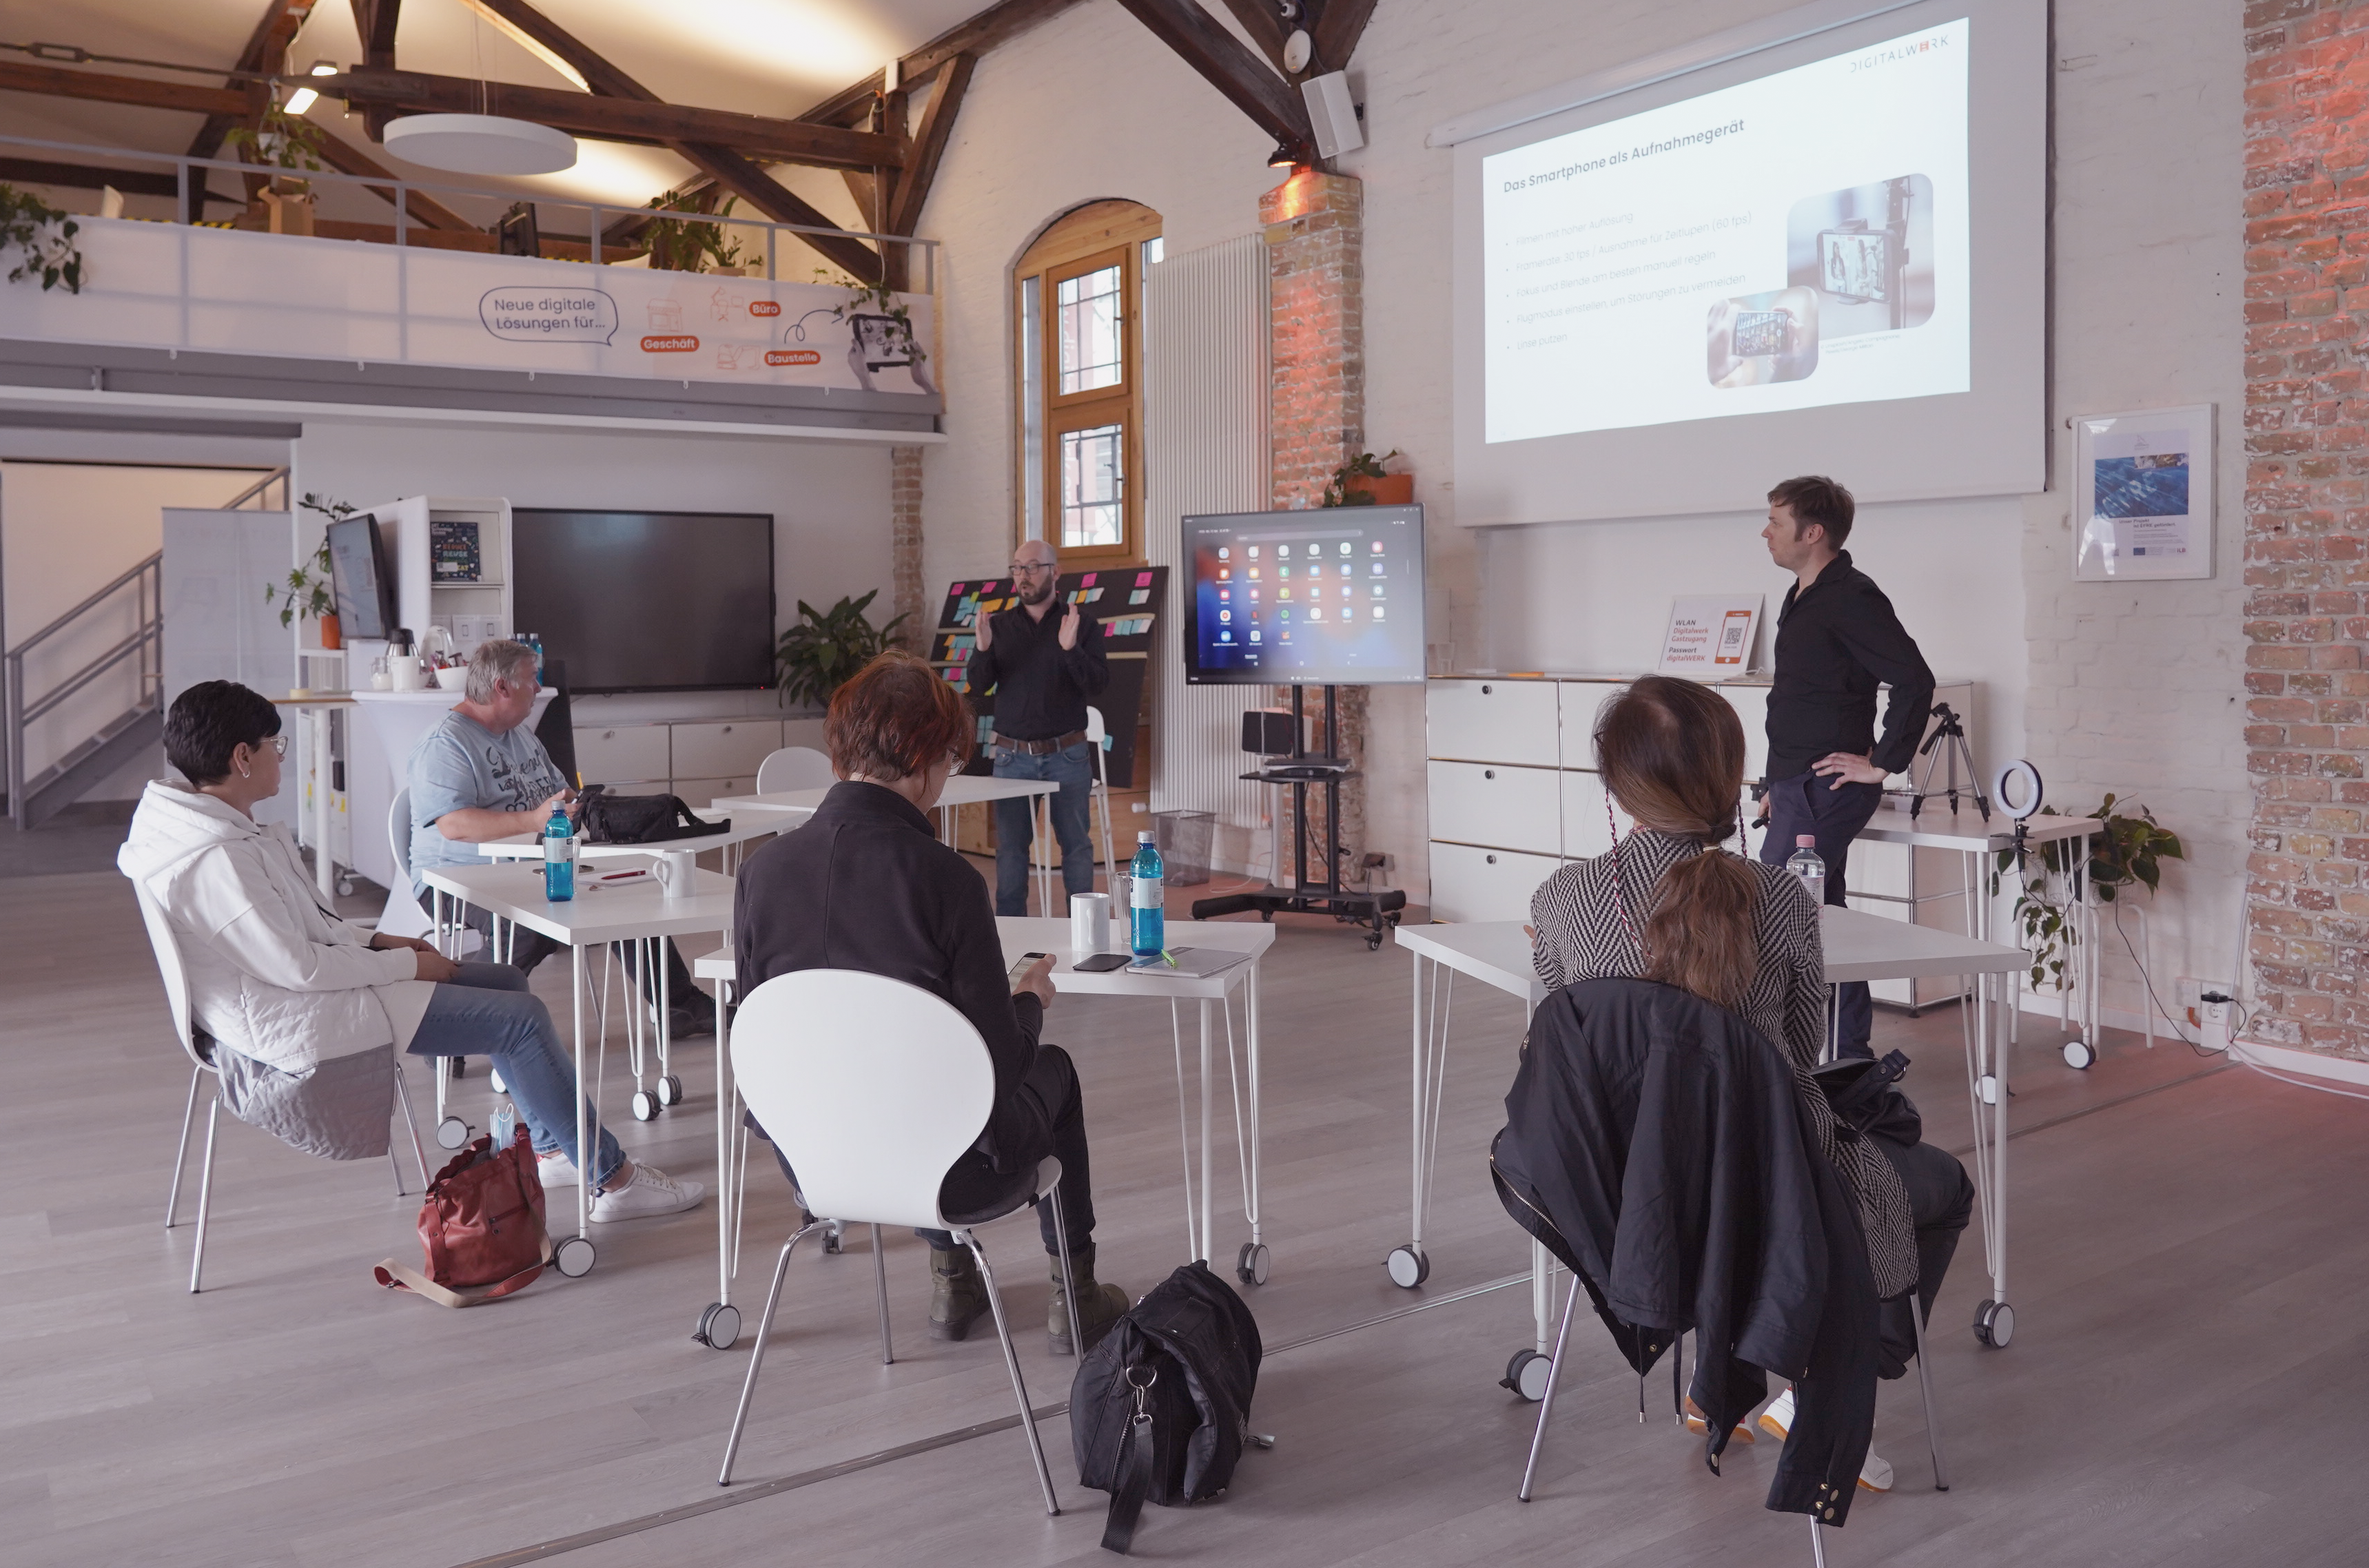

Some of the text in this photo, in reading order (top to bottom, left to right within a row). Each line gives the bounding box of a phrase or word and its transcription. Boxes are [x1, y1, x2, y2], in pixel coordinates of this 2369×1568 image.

[1504, 119, 1745, 193] Das Smartphone als Aufnahmegerät
[1516, 212, 1634, 246] Filmen mit hoher Auflösung
[1563, 251, 1575, 263] 30
[1576, 247, 1590, 264] fps
[1598, 236, 1648, 256] Ausnahme
[1650, 232, 1663, 245] für
[1665, 222, 1710, 242] Zeitlupen
[1712, 217, 1730, 234] (60
[1731, 209, 1752, 229] fps)
[1517, 250, 1717, 298] Fokus und Blende am besten manuell regeln
[495, 298, 596, 314] Neue digitale
[1517, 308, 1563, 326] Flugmodus
[1610, 296, 1626, 308] um
[1627, 286, 1676, 304] Störungen
[1678, 284, 1690, 295] zu
[1691, 273, 1747, 293] vermeiden
[752, 303, 779, 314] Büro
[496, 316, 606, 333] Lösungen für...
[644, 338, 696, 349] Geschäft
[1517, 332, 1568, 351] Linse putzen
[767, 353, 819, 364] Baustelle
[1671, 635, 1707, 643] Gastzugang
[1673, 627, 1709, 635] Digitalwerk
